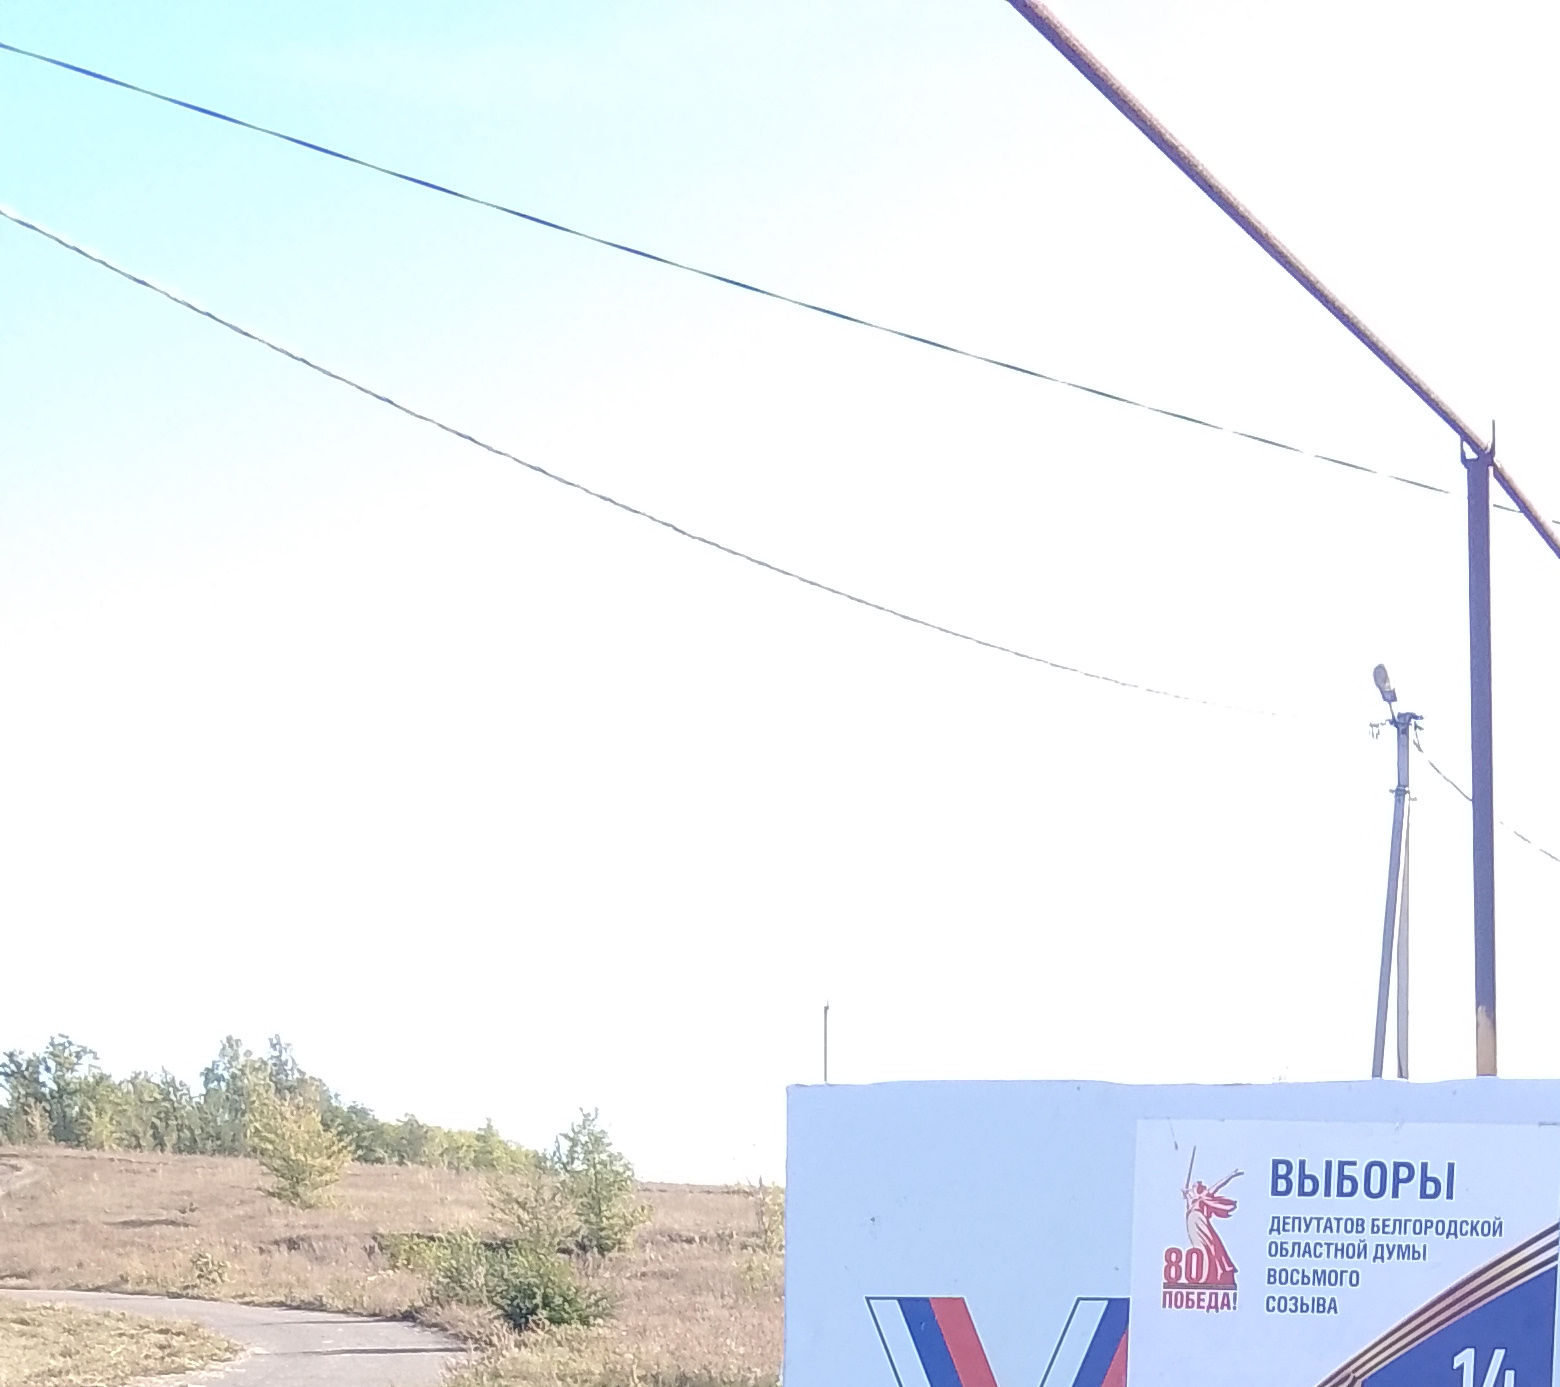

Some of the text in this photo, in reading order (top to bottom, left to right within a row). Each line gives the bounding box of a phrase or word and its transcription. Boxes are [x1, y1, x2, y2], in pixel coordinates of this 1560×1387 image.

[1270, 1158, 1456, 1201] ВЫБОРЫ
[1268, 1215, 1504, 1239] ДЕПУТАТОВ БЕЛГОРОДСКОЙ
[1267, 1239, 1428, 1263] ОБЛАСТНОЙ ДУМЫ
[1164, 1248, 1208, 1285] 80
[1266, 1268, 1361, 1288] ВОСЬМОГО
[1162, 1290, 1238, 1313] ПОБЕДА!
[1265, 1296, 1339, 1315] СОЗЫВА
